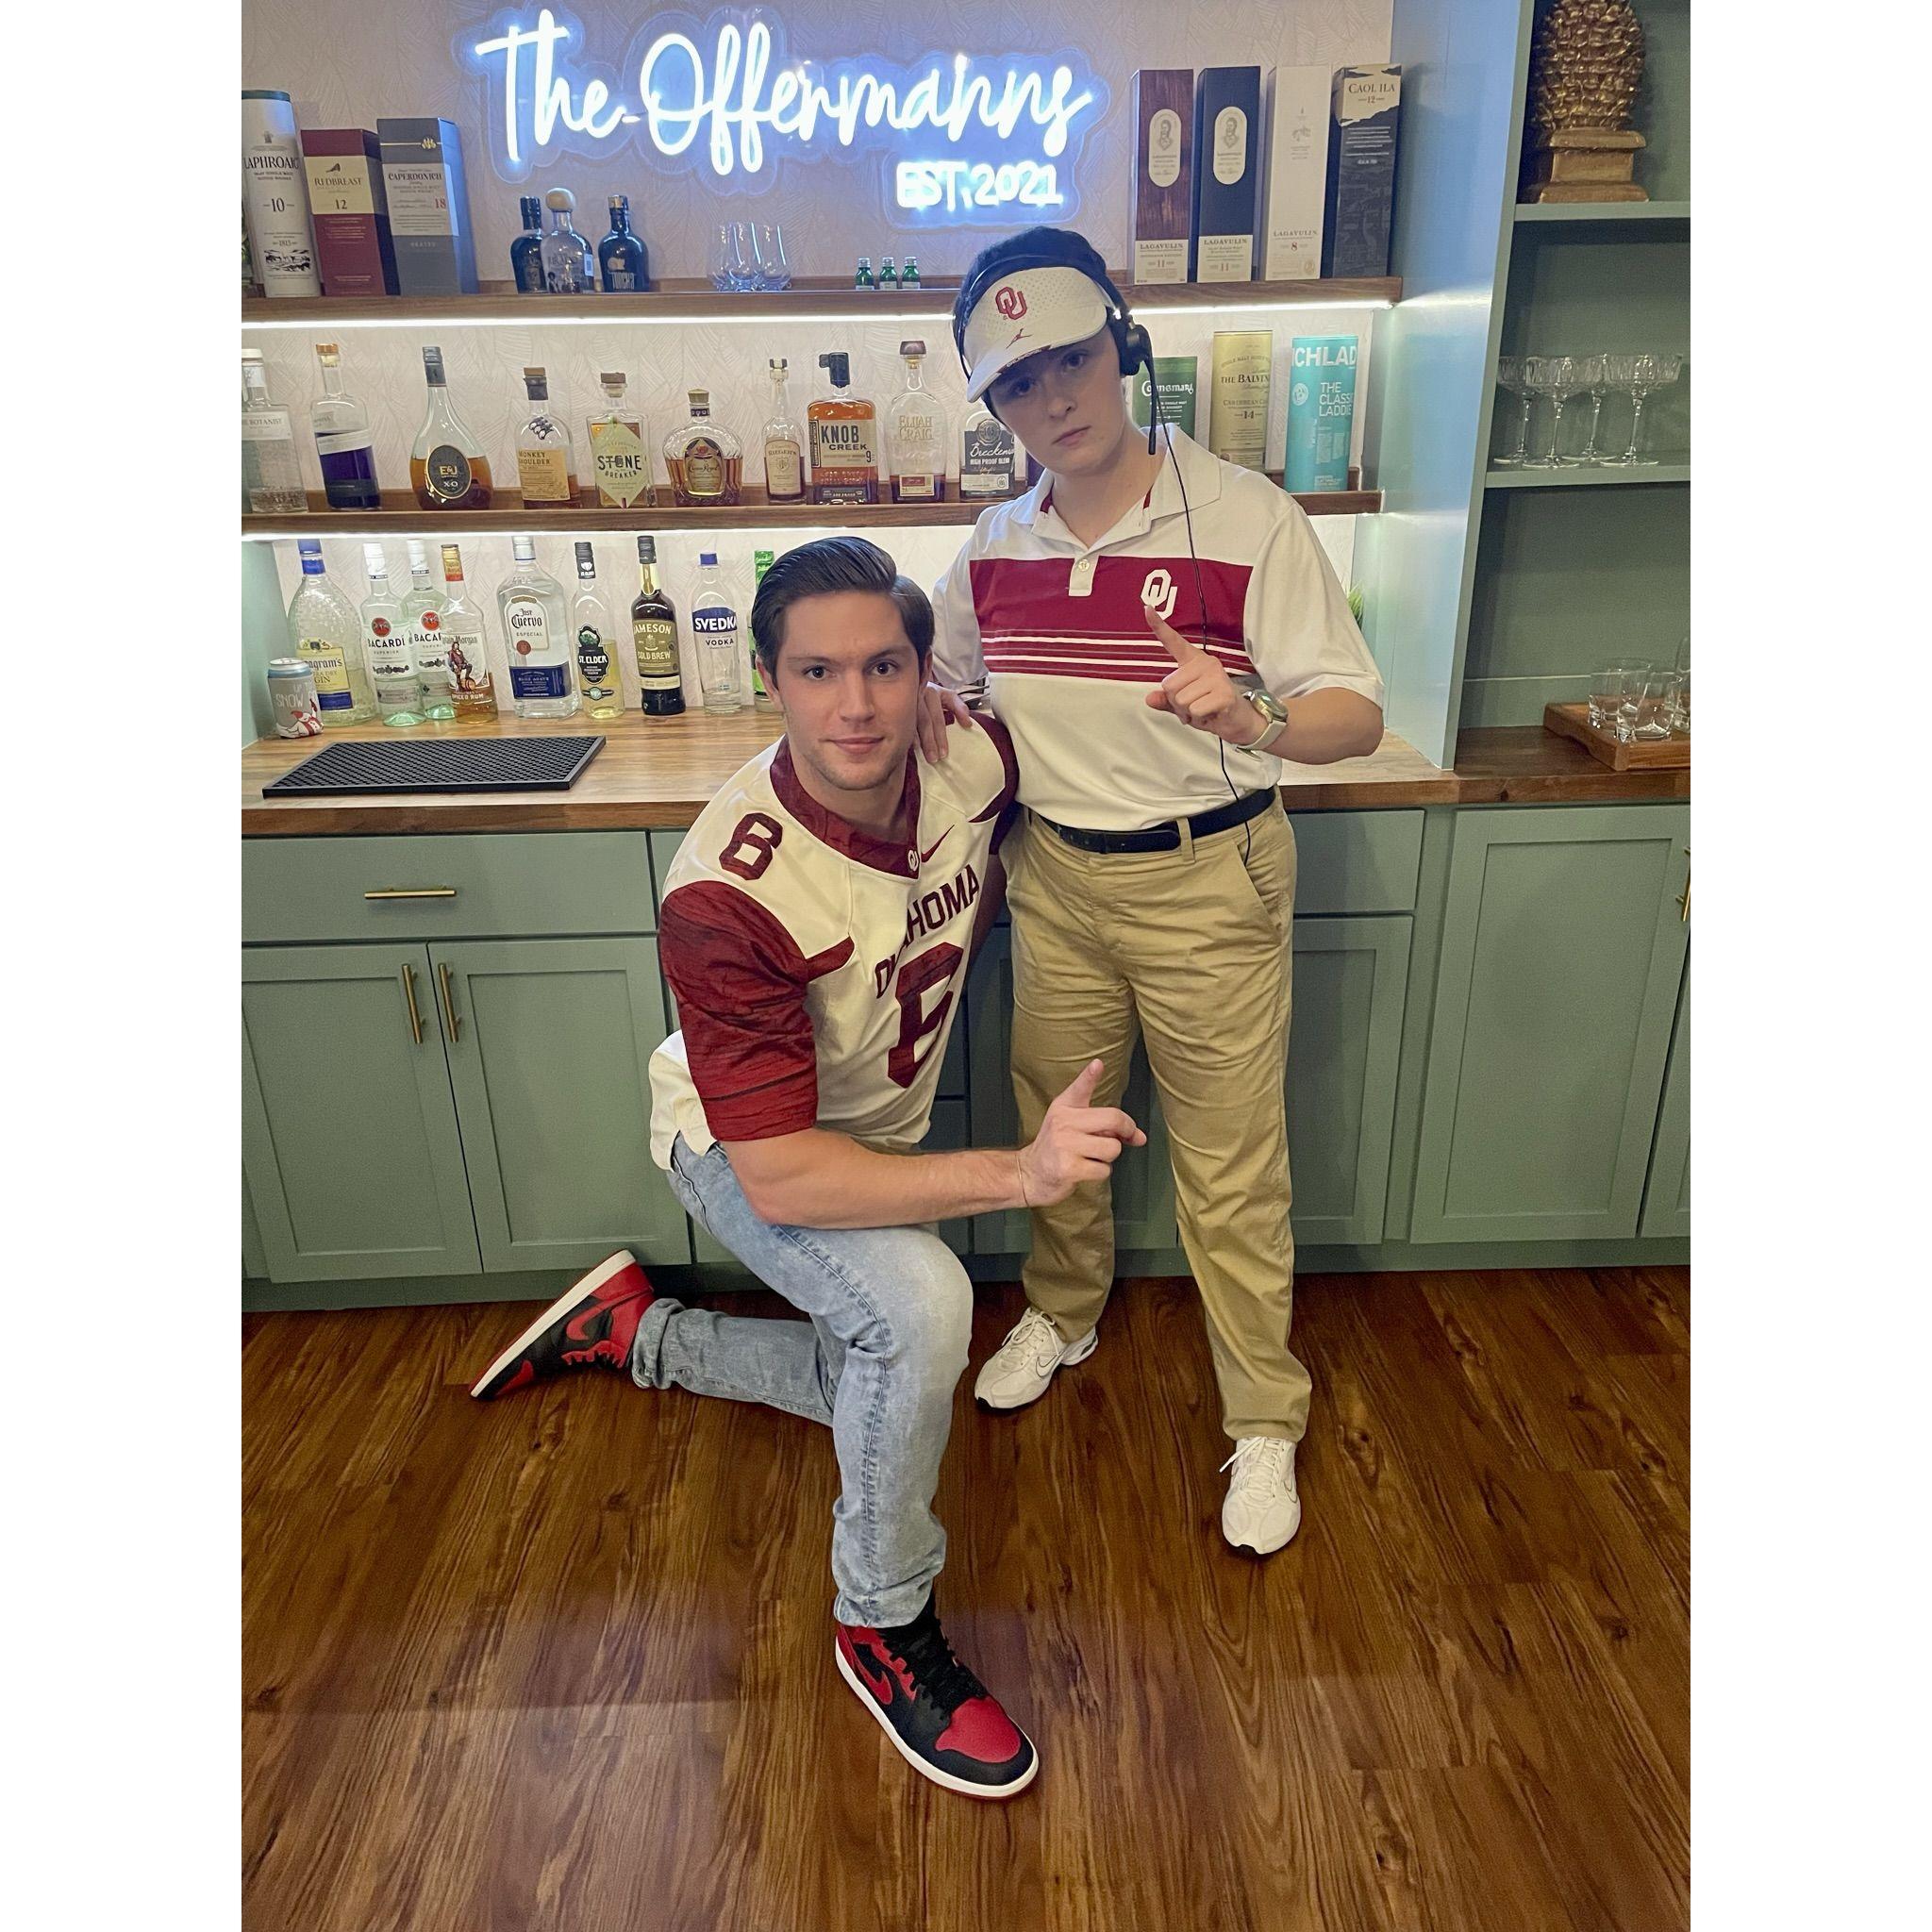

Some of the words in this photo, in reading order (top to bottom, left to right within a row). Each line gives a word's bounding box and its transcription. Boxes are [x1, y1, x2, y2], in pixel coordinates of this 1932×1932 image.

[475, 9, 626, 161] The
[640, 23, 1092, 175] Offermanns
[1348, 83, 1377, 93] CAOL
[1379, 82, 1395, 92] ILA
[314, 177, 362, 186] REDBREAST
[271, 197, 285, 212] 10
[335, 199, 347, 209] 12
[434, 197, 447, 209] 18
[1291, 242, 1298, 252] 8
[995, 286, 1027, 320] OU
[1320, 382, 1341, 393] THE
[1243, 410, 1254, 419] 14
[898, 415, 934, 427] ELIJAH
[821, 425, 859, 444] KNOB
[898, 427, 934, 441] CRAIG
[865, 450, 872, 462] 9
[597, 455, 642, 471] STONE
[439, 465, 458, 475] E&J
[605, 470, 638, 479] BREAKER
[1141, 568, 1178, 620] OU
[511, 613, 542, 629] Cuervo
[706, 638, 734, 646] VODKA
[651, 651, 671, 660] BREW
[275, 693, 304, 708] SNOW
